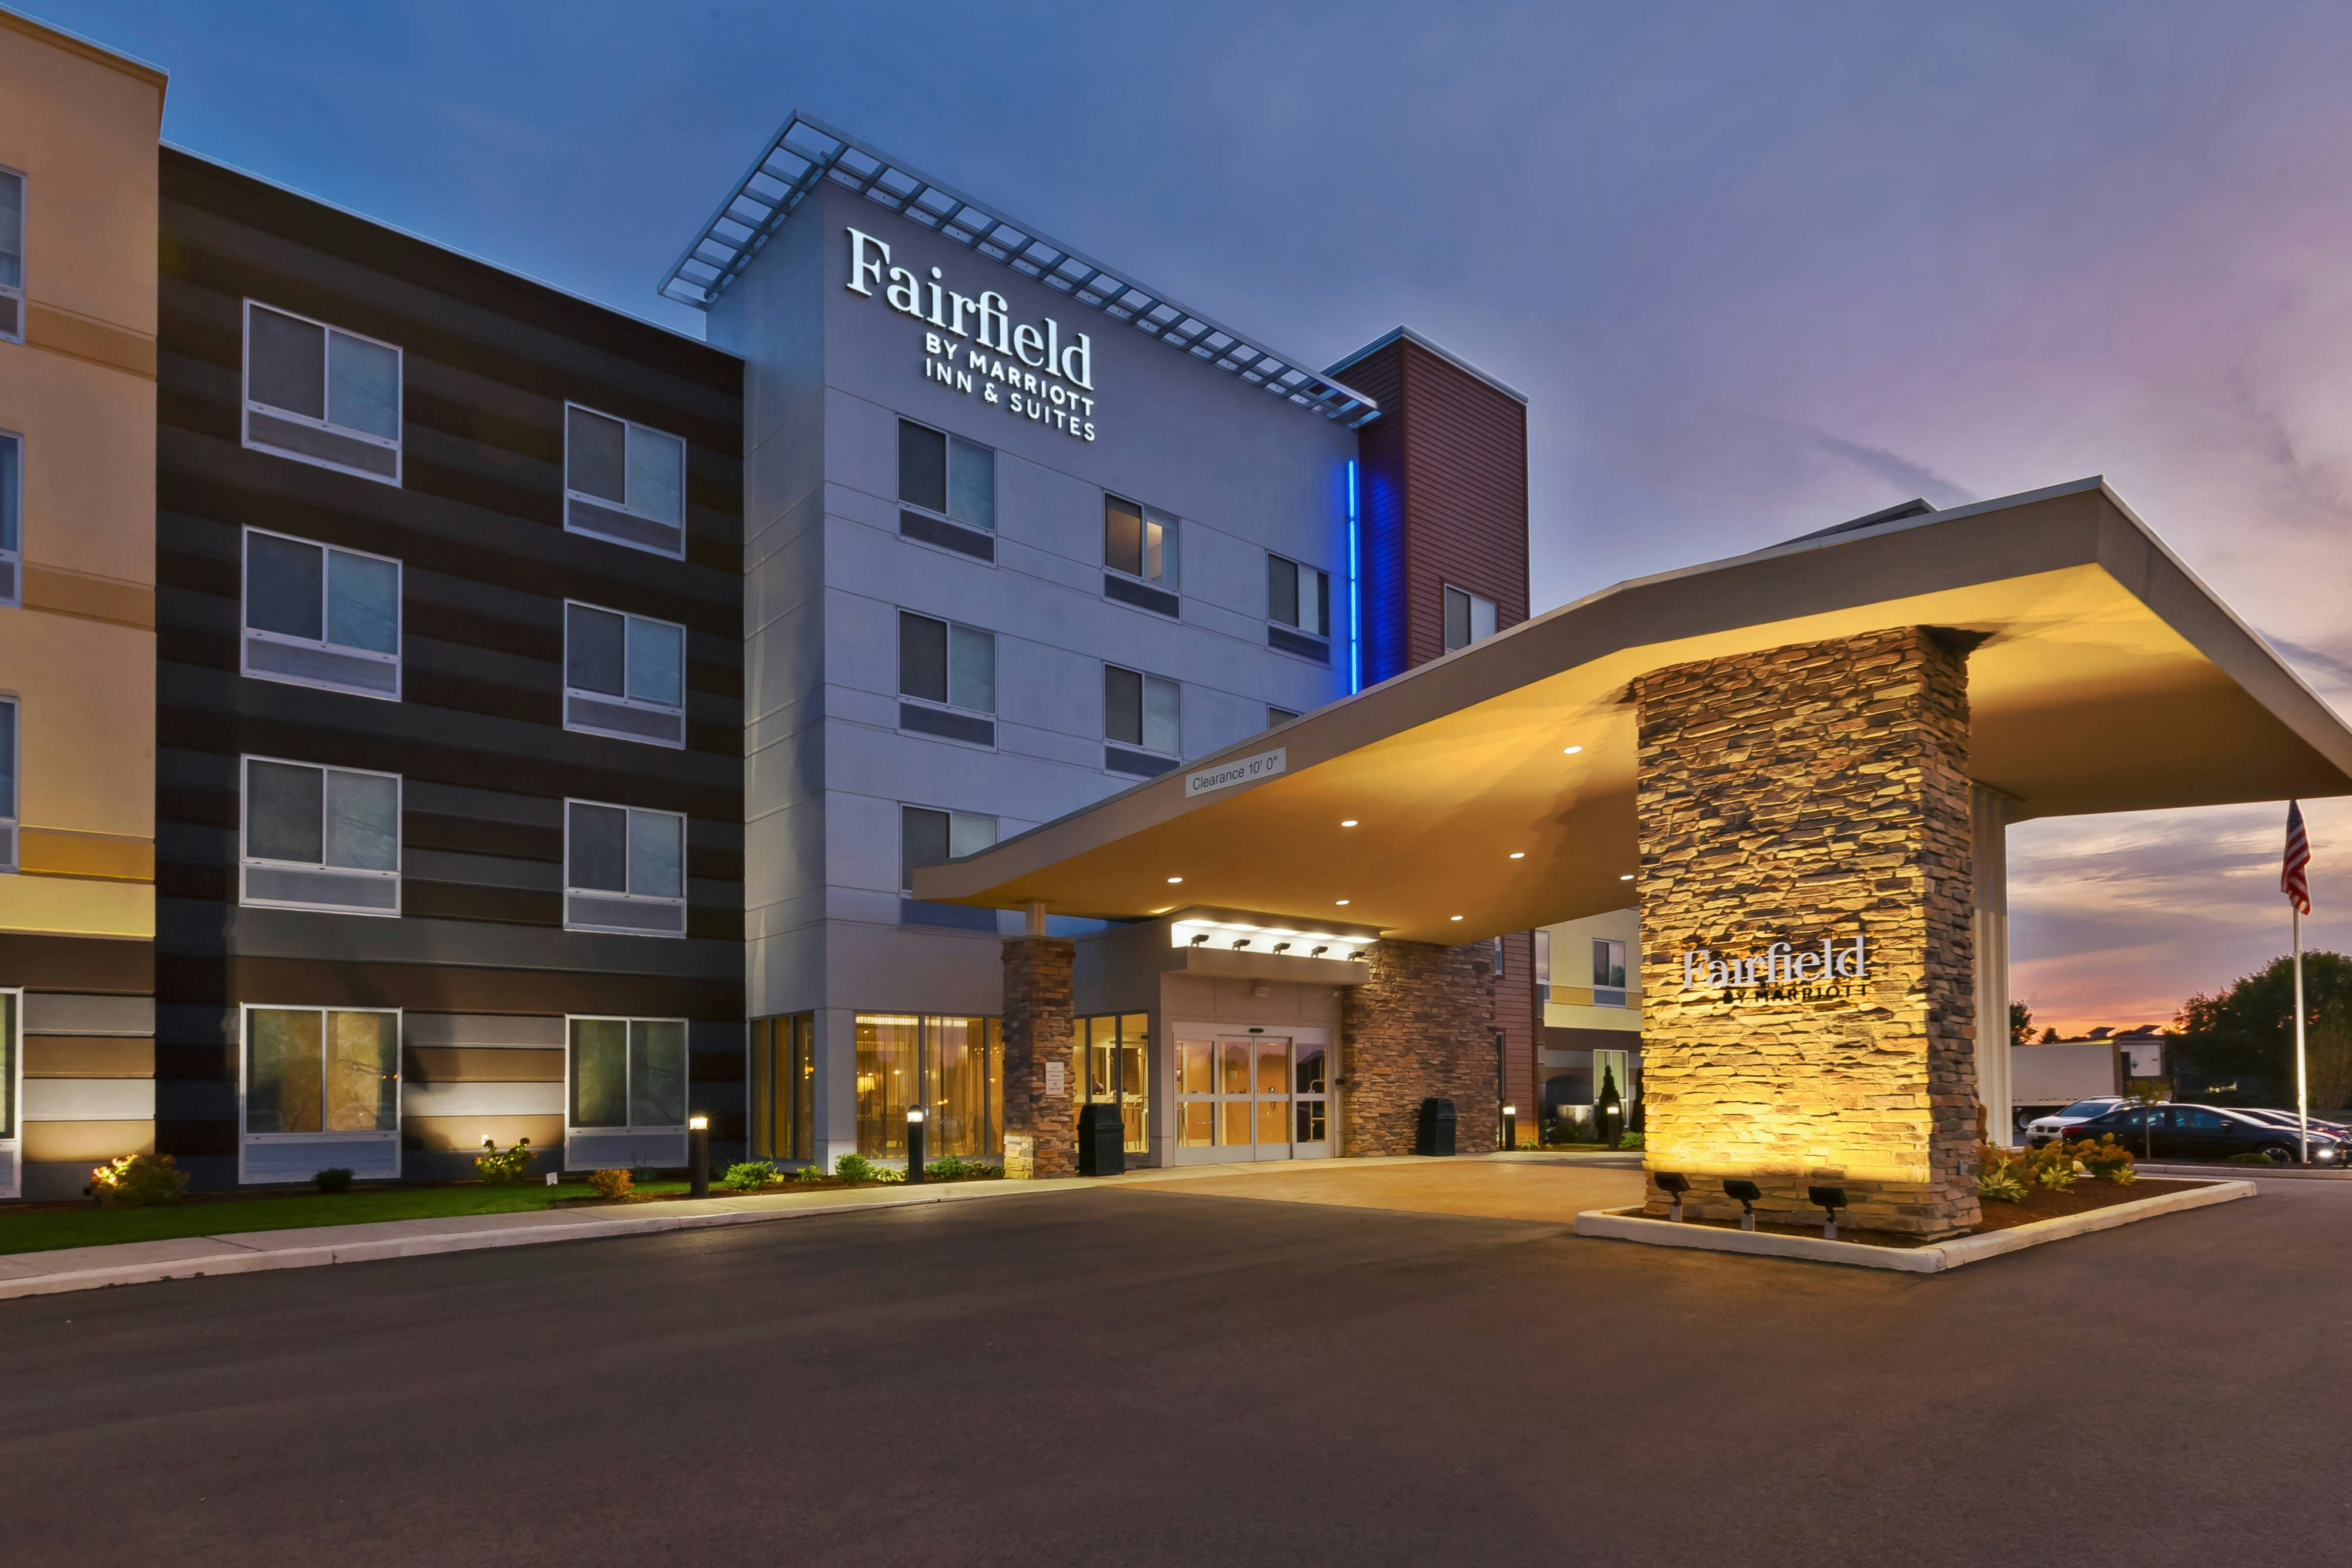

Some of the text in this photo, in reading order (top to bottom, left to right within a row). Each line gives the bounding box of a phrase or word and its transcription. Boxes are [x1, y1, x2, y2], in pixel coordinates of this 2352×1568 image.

[846, 226, 1095, 391] Fairfield
[926, 332, 1095, 417] BY MARRIOTT
[926, 357, 1095, 442] INN & SUITES
[1192, 768, 1244, 790] Clearance
[1248, 760, 1262, 775] 10'
[1682, 935, 1868, 989] Fairfield
[1755, 984, 1870, 1002] MARRIOTT
